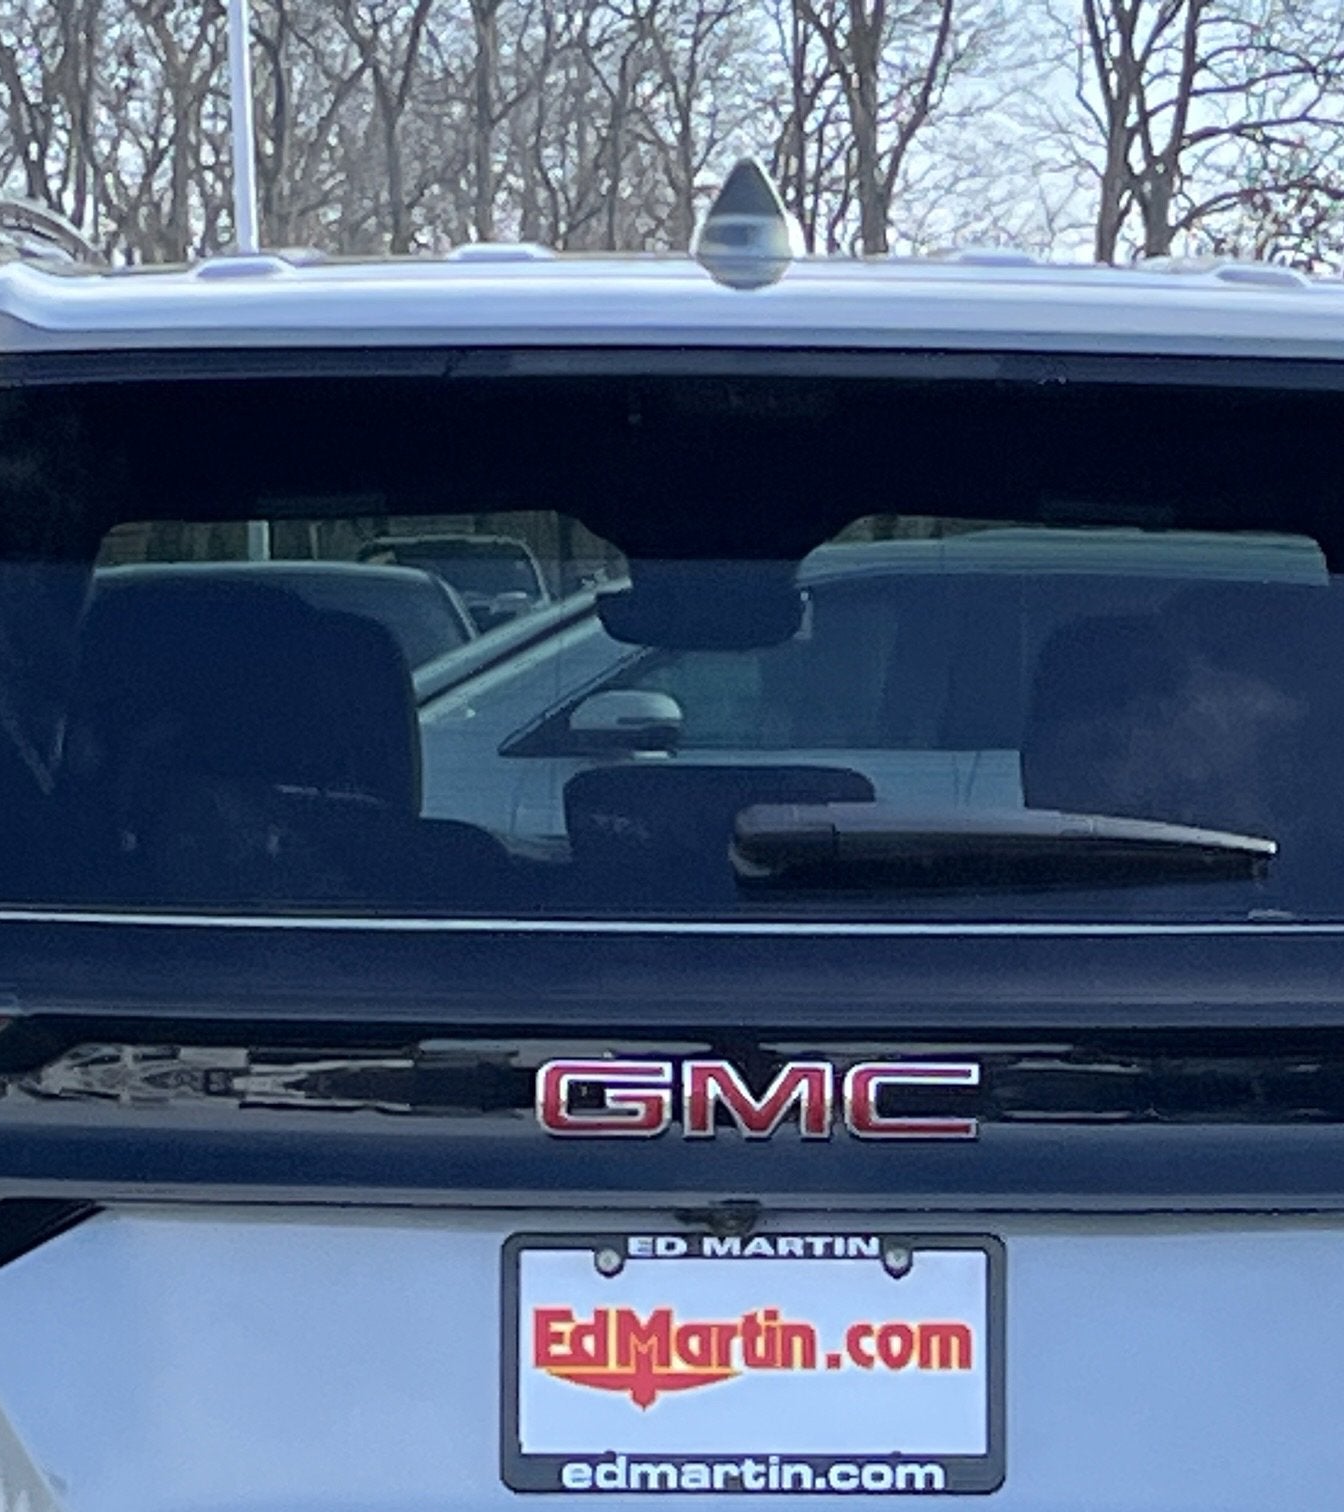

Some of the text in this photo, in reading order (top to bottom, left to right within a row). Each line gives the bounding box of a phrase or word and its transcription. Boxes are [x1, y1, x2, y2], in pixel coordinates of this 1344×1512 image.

[535, 1059, 980, 1139] GMC
[627, 1236, 880, 1257] ED MARTIN
[561, 1456, 946, 1491] edmartin.com
